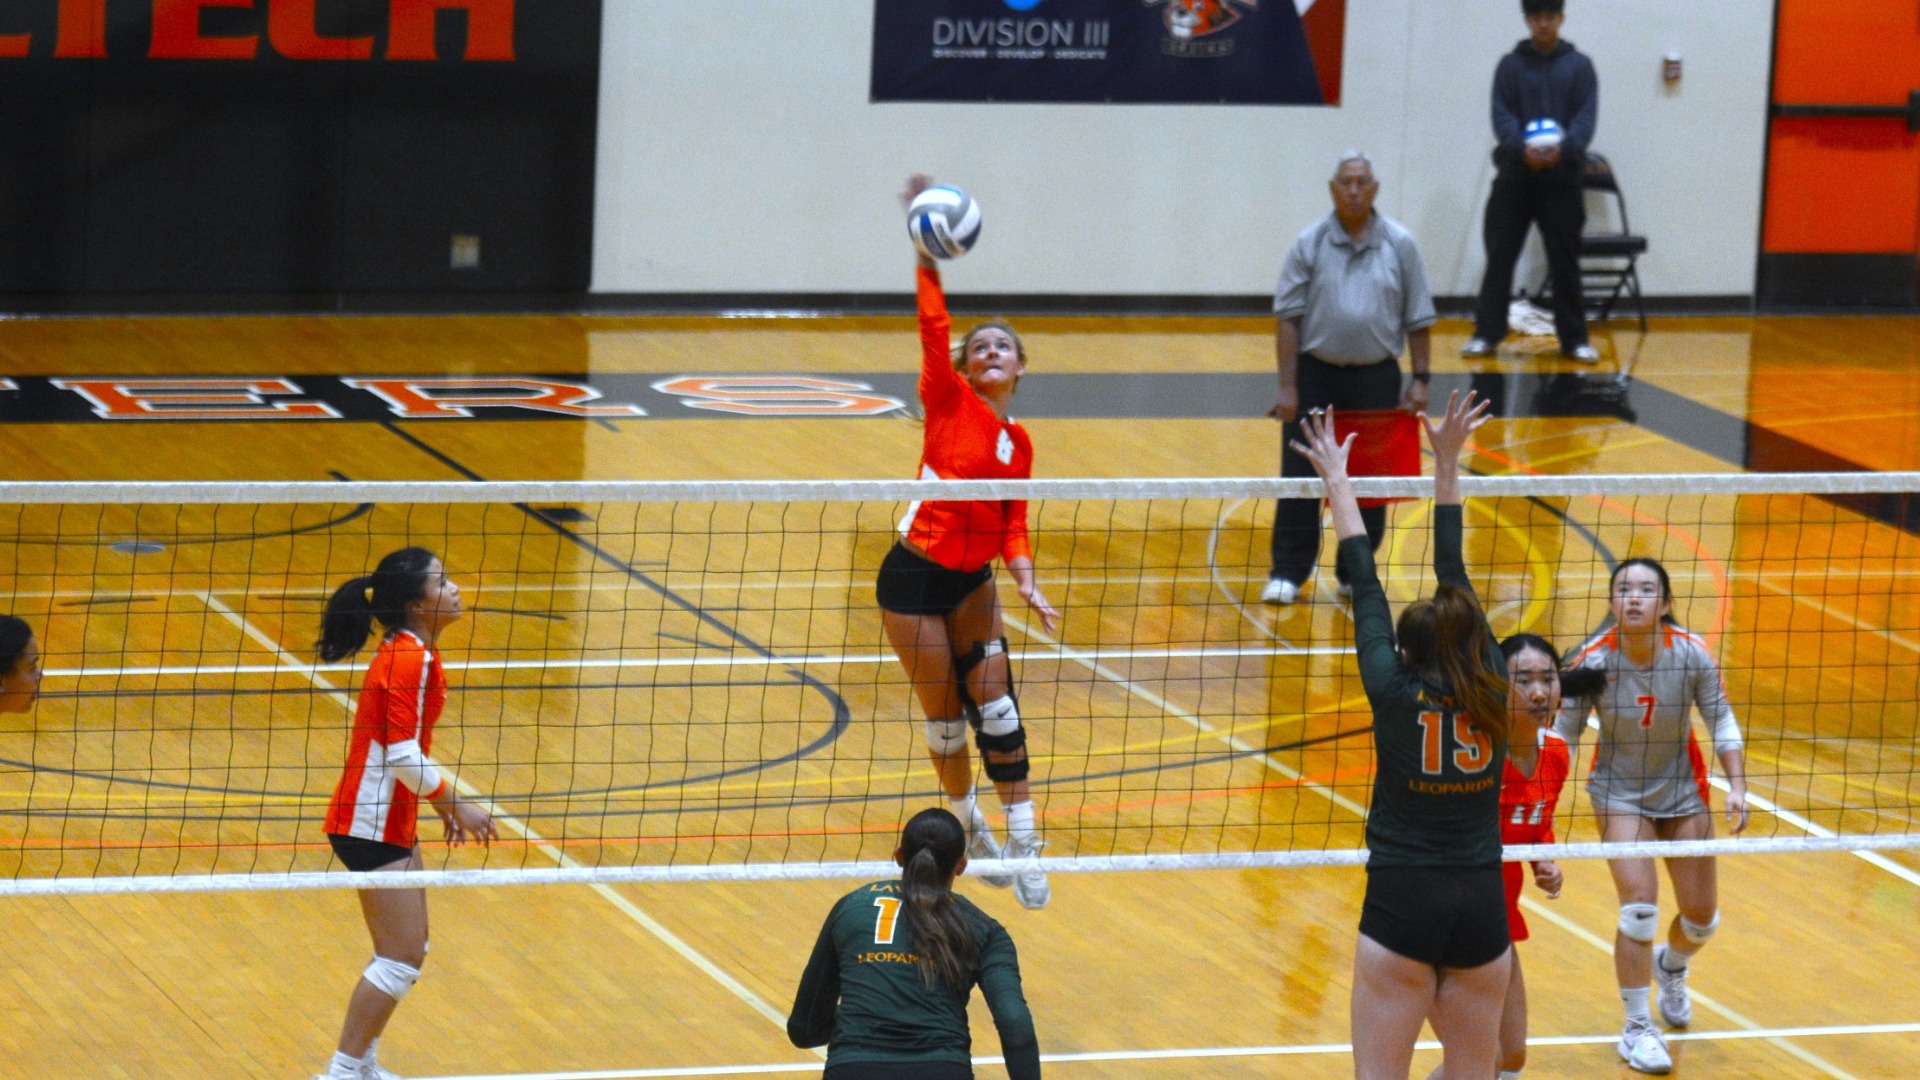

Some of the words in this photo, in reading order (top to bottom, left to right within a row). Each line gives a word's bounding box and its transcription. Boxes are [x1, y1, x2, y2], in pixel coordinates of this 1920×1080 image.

[933, 19, 1074, 46] DIVISION
[1084, 21, 1109, 46] III
[1635, 694, 1656, 728] 7
[1418, 711, 1493, 775] 15
[1407, 776, 1494, 795] LEOPARDS
[873, 897, 903, 944] 1
